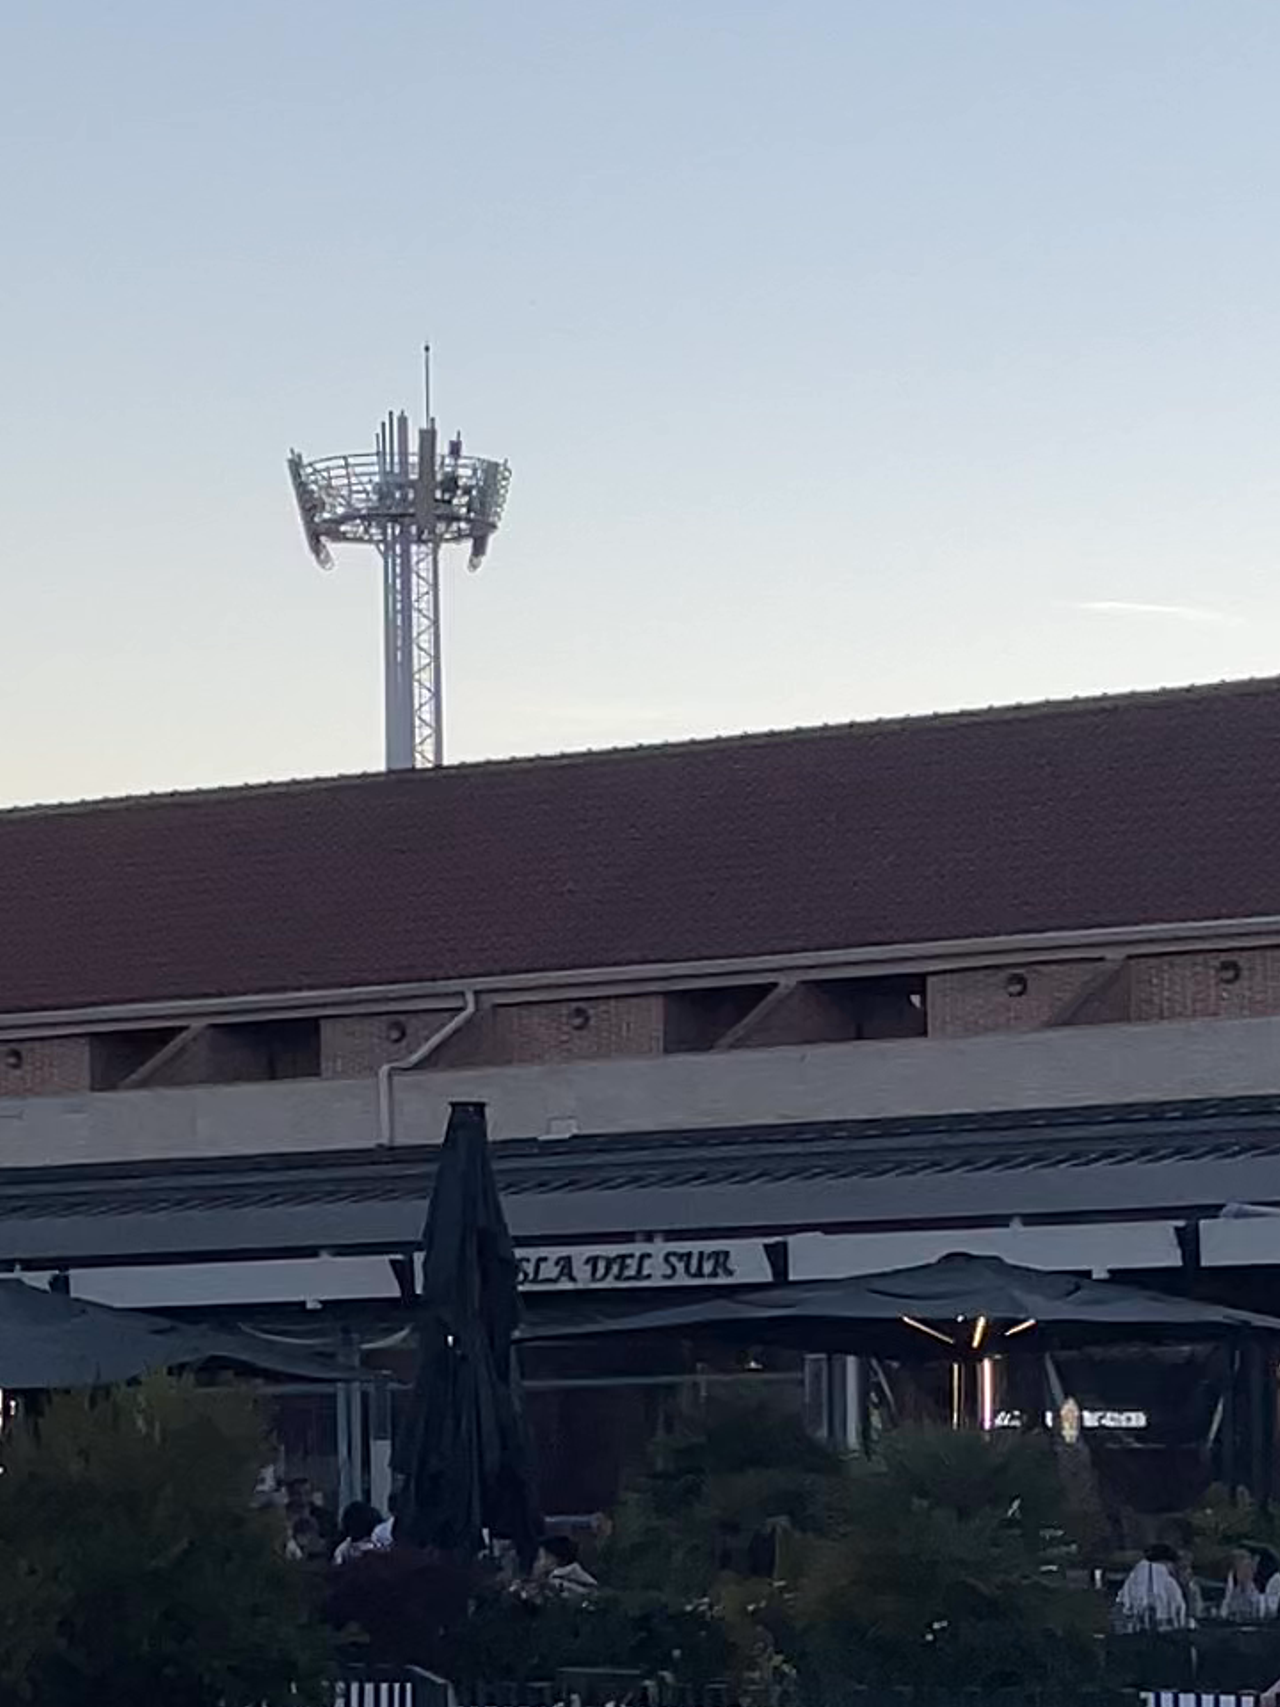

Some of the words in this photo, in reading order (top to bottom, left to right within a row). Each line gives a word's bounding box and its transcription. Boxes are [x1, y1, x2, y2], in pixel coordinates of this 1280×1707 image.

[516, 1255, 578, 1285] SLA
[584, 1251, 653, 1282] DEL
[661, 1250, 736, 1279] SUR
